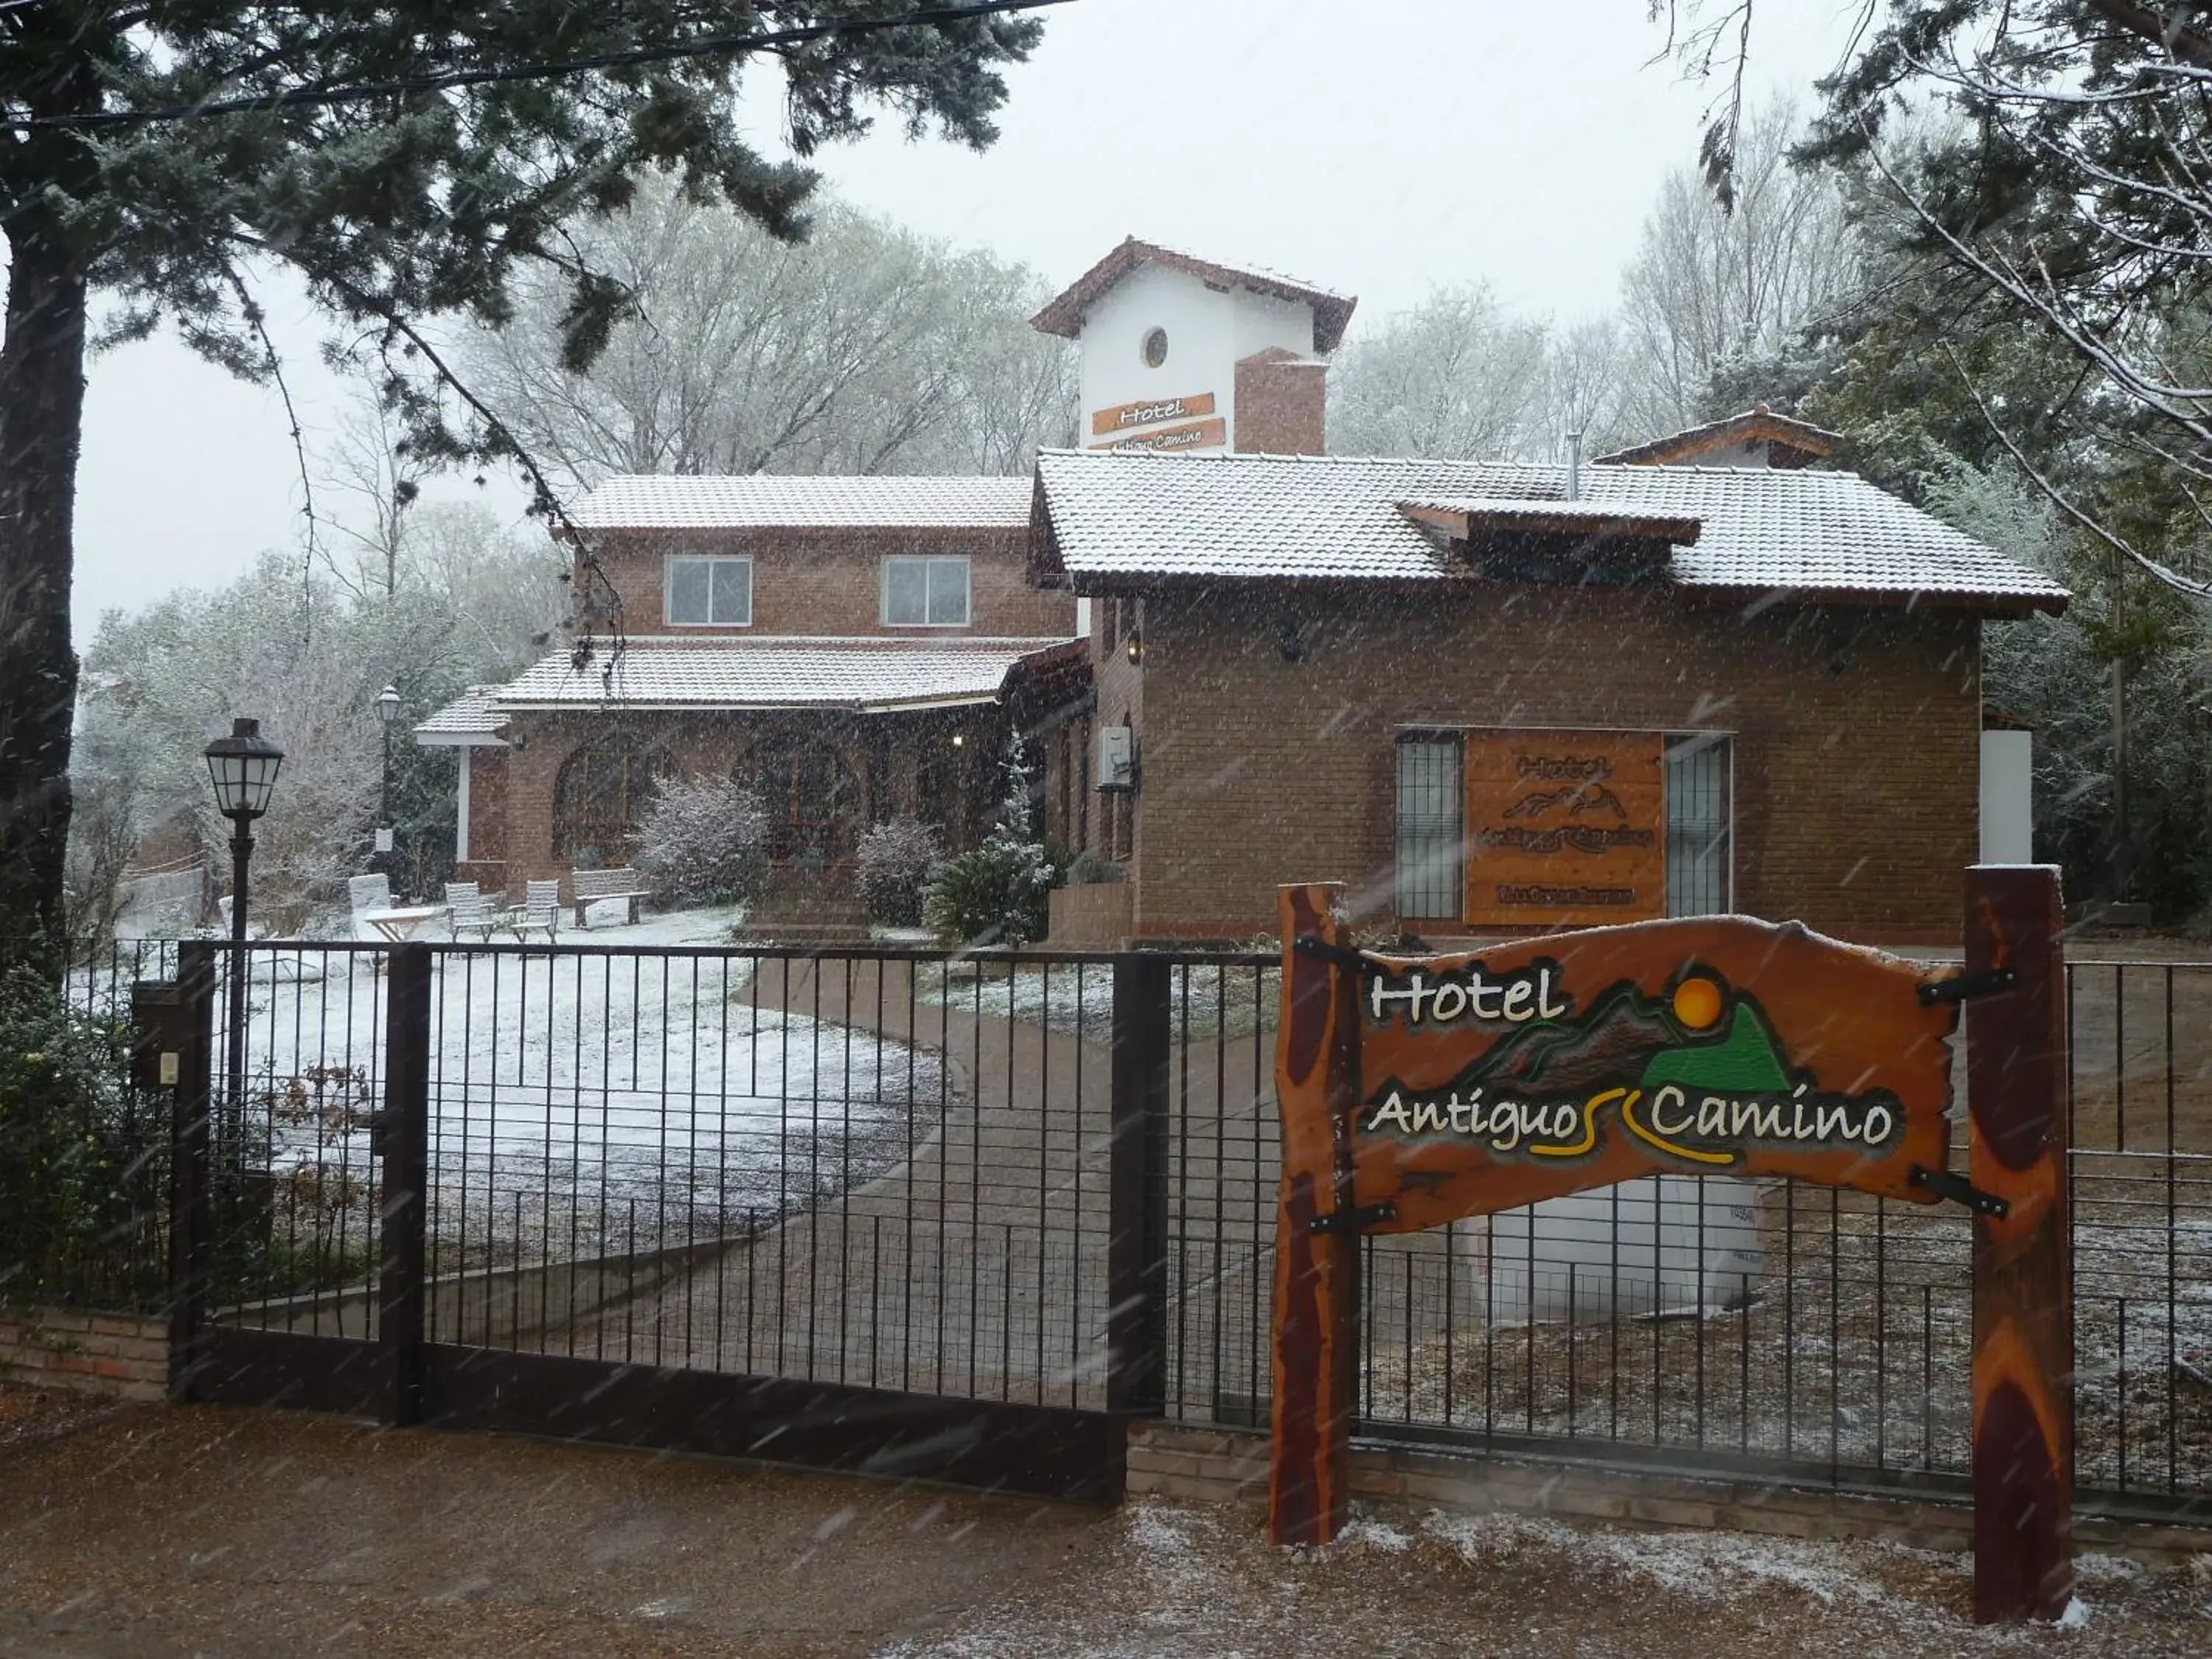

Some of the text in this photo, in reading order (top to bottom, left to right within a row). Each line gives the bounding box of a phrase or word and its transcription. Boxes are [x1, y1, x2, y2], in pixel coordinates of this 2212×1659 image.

[1120, 400, 1185, 424] Hotel
[1155, 430, 1202, 448] Camino
[1517, 756, 1612, 779] Hotel
[1371, 968, 1565, 1023] Hotel
[1368, 1083, 1892, 1150] Antiguo Camino
